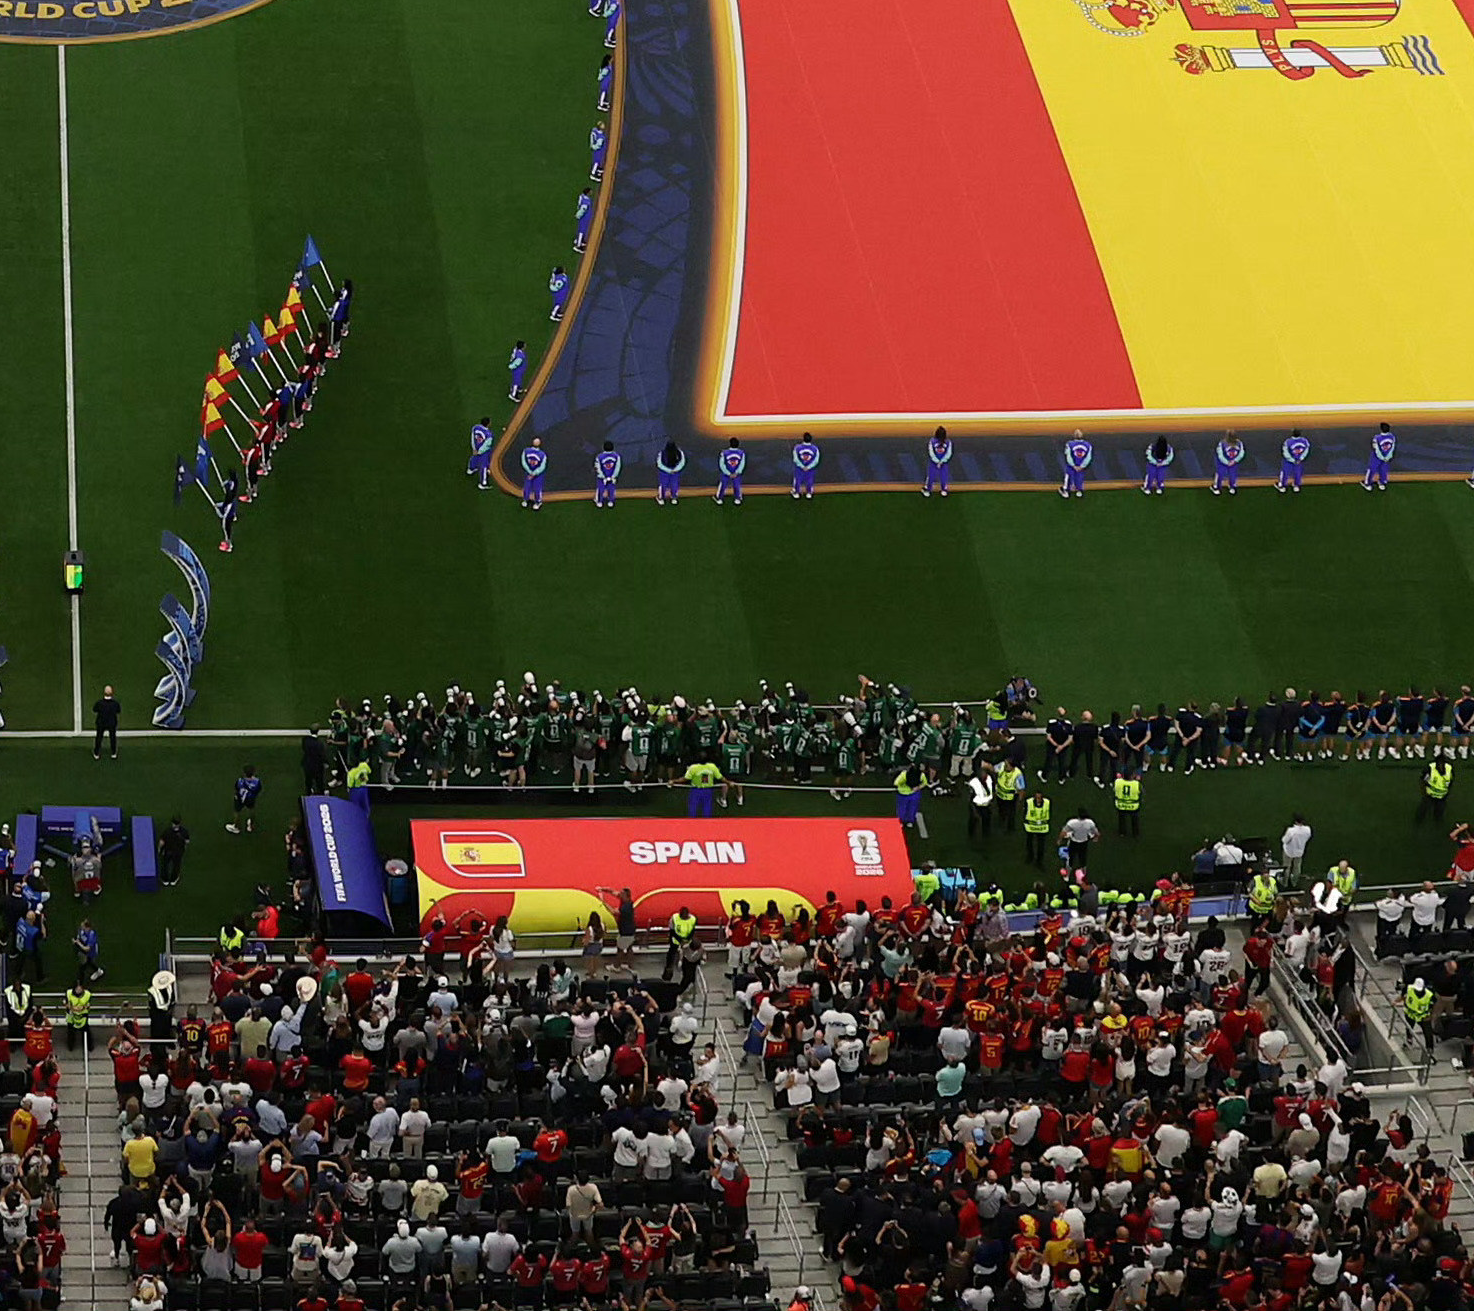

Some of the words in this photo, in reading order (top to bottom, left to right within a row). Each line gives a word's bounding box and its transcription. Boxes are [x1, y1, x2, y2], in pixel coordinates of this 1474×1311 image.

[319, 804, 335, 834] 2026
[325, 834, 338, 851] CUP
[629, 841, 747, 865] SPAIN
[329, 851, 343, 882] WORLD
[335, 881, 347, 902] FIFA
[186, 1030, 198, 1042] 10
